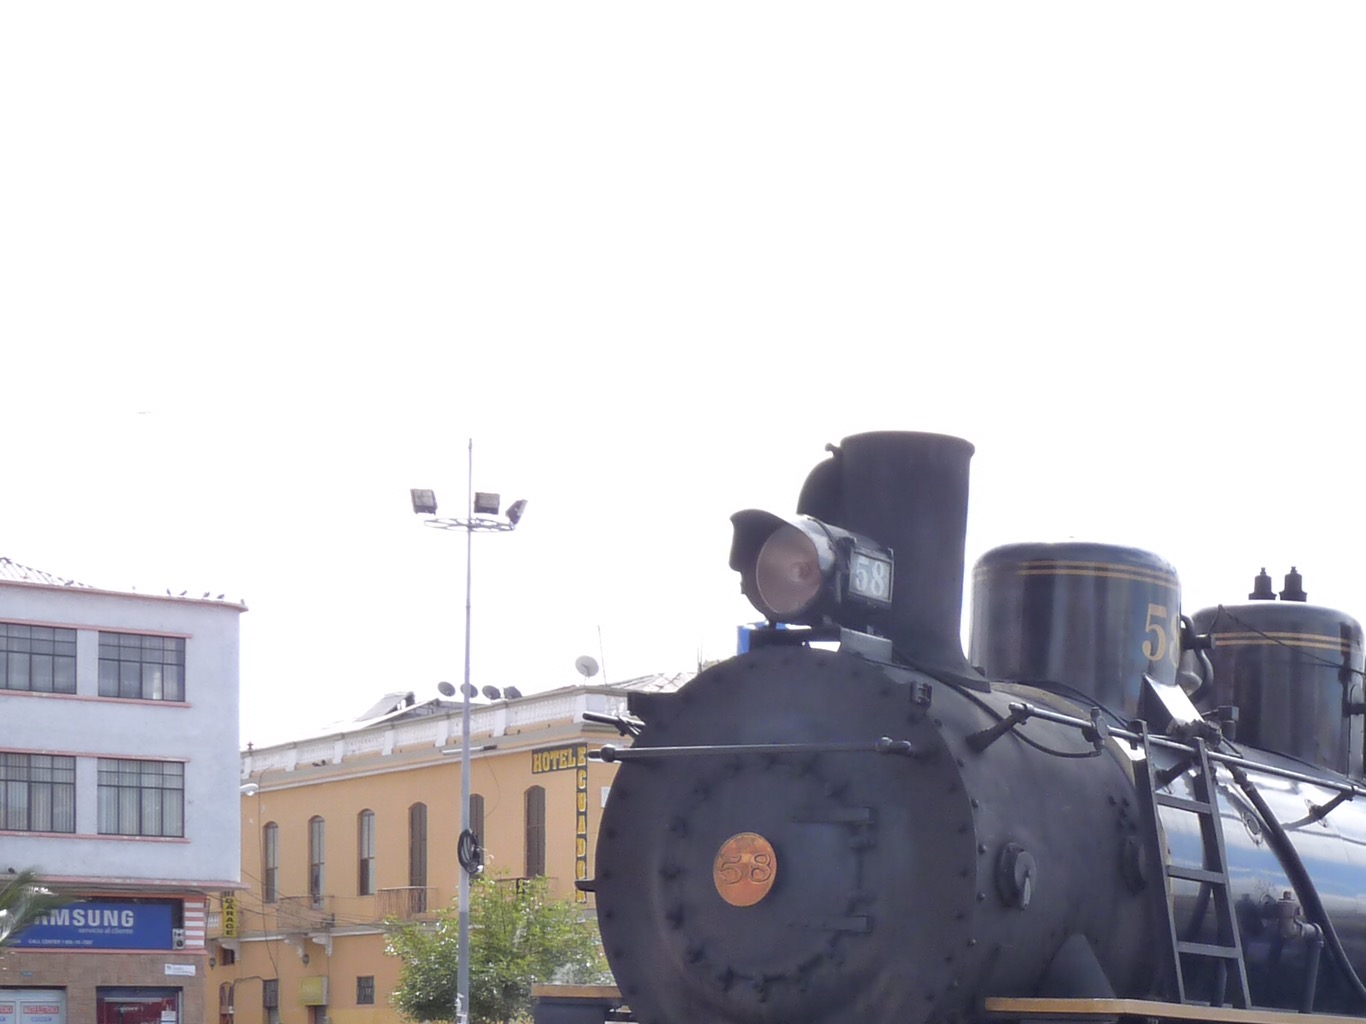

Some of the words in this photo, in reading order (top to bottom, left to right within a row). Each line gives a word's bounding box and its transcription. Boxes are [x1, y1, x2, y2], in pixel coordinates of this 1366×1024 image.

[856, 555, 885, 596] 58
[533, 749, 576, 773] HOTEL
[719, 852, 772, 885] 58
[34, 908, 135, 927] AMSUNG
